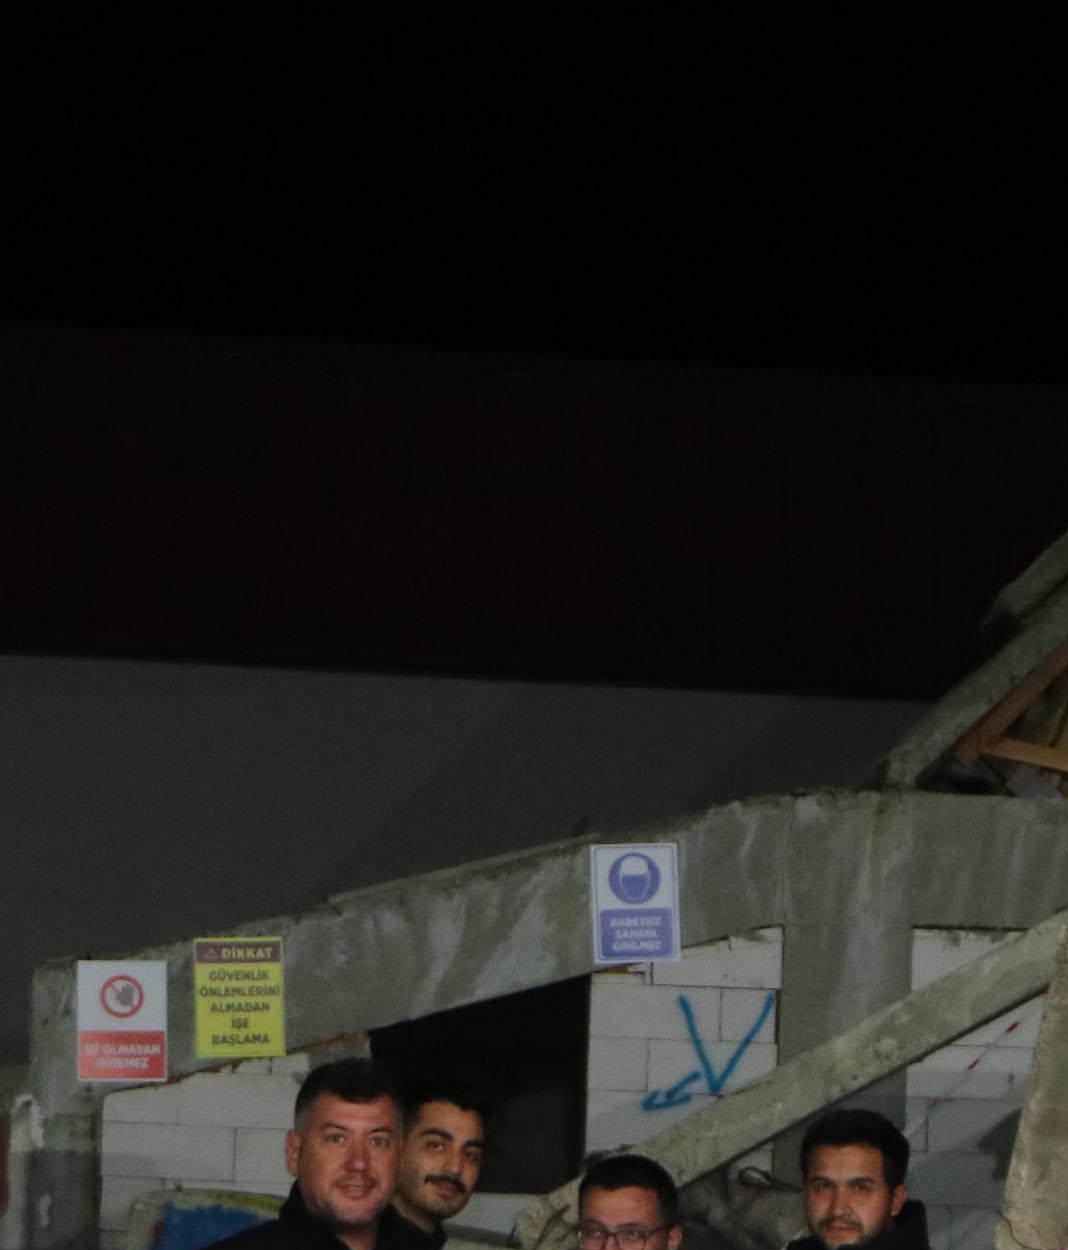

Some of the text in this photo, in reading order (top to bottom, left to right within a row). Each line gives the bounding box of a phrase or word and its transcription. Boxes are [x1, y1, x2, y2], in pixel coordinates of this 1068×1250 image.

[222, 946, 273, 959] DİKKAT
[209, 967, 269, 981] GÜVENLİK
[199, 983, 281, 997] ÖNLEMLERİNİ
[210, 1001, 270, 1013] ALMADAN
[231, 1015, 250, 1029] İŞE
[211, 1033, 270, 1046] BAŞLAMA
